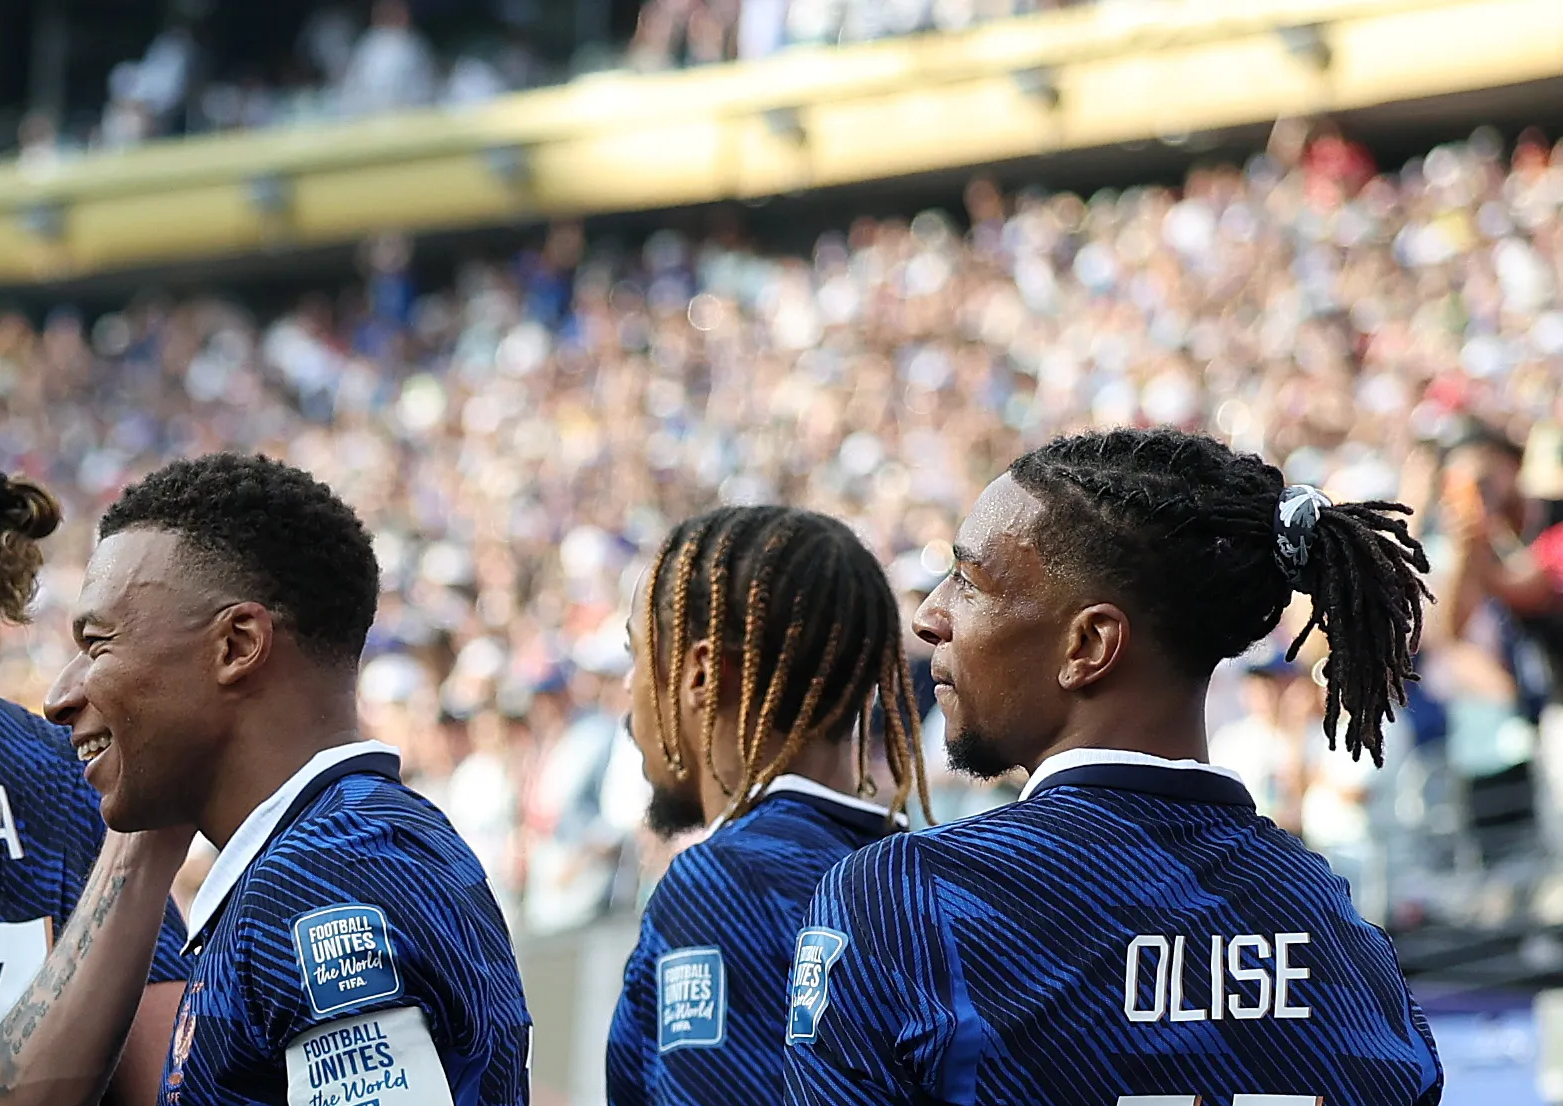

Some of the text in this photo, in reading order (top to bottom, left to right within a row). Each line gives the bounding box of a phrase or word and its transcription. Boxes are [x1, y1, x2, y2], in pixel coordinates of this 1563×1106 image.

[308, 915, 372, 944] FOOTBALL
[311, 931, 377, 964] UNITES
[313, 950, 383, 985] the World
[338, 976, 366, 992] FIFA
[1123, 932, 1312, 1022] OLISE
[302, 1021, 387, 1062] FOOTBALL
[308, 1041, 395, 1089] UNITES
[341, 1068, 409, 1103] World
